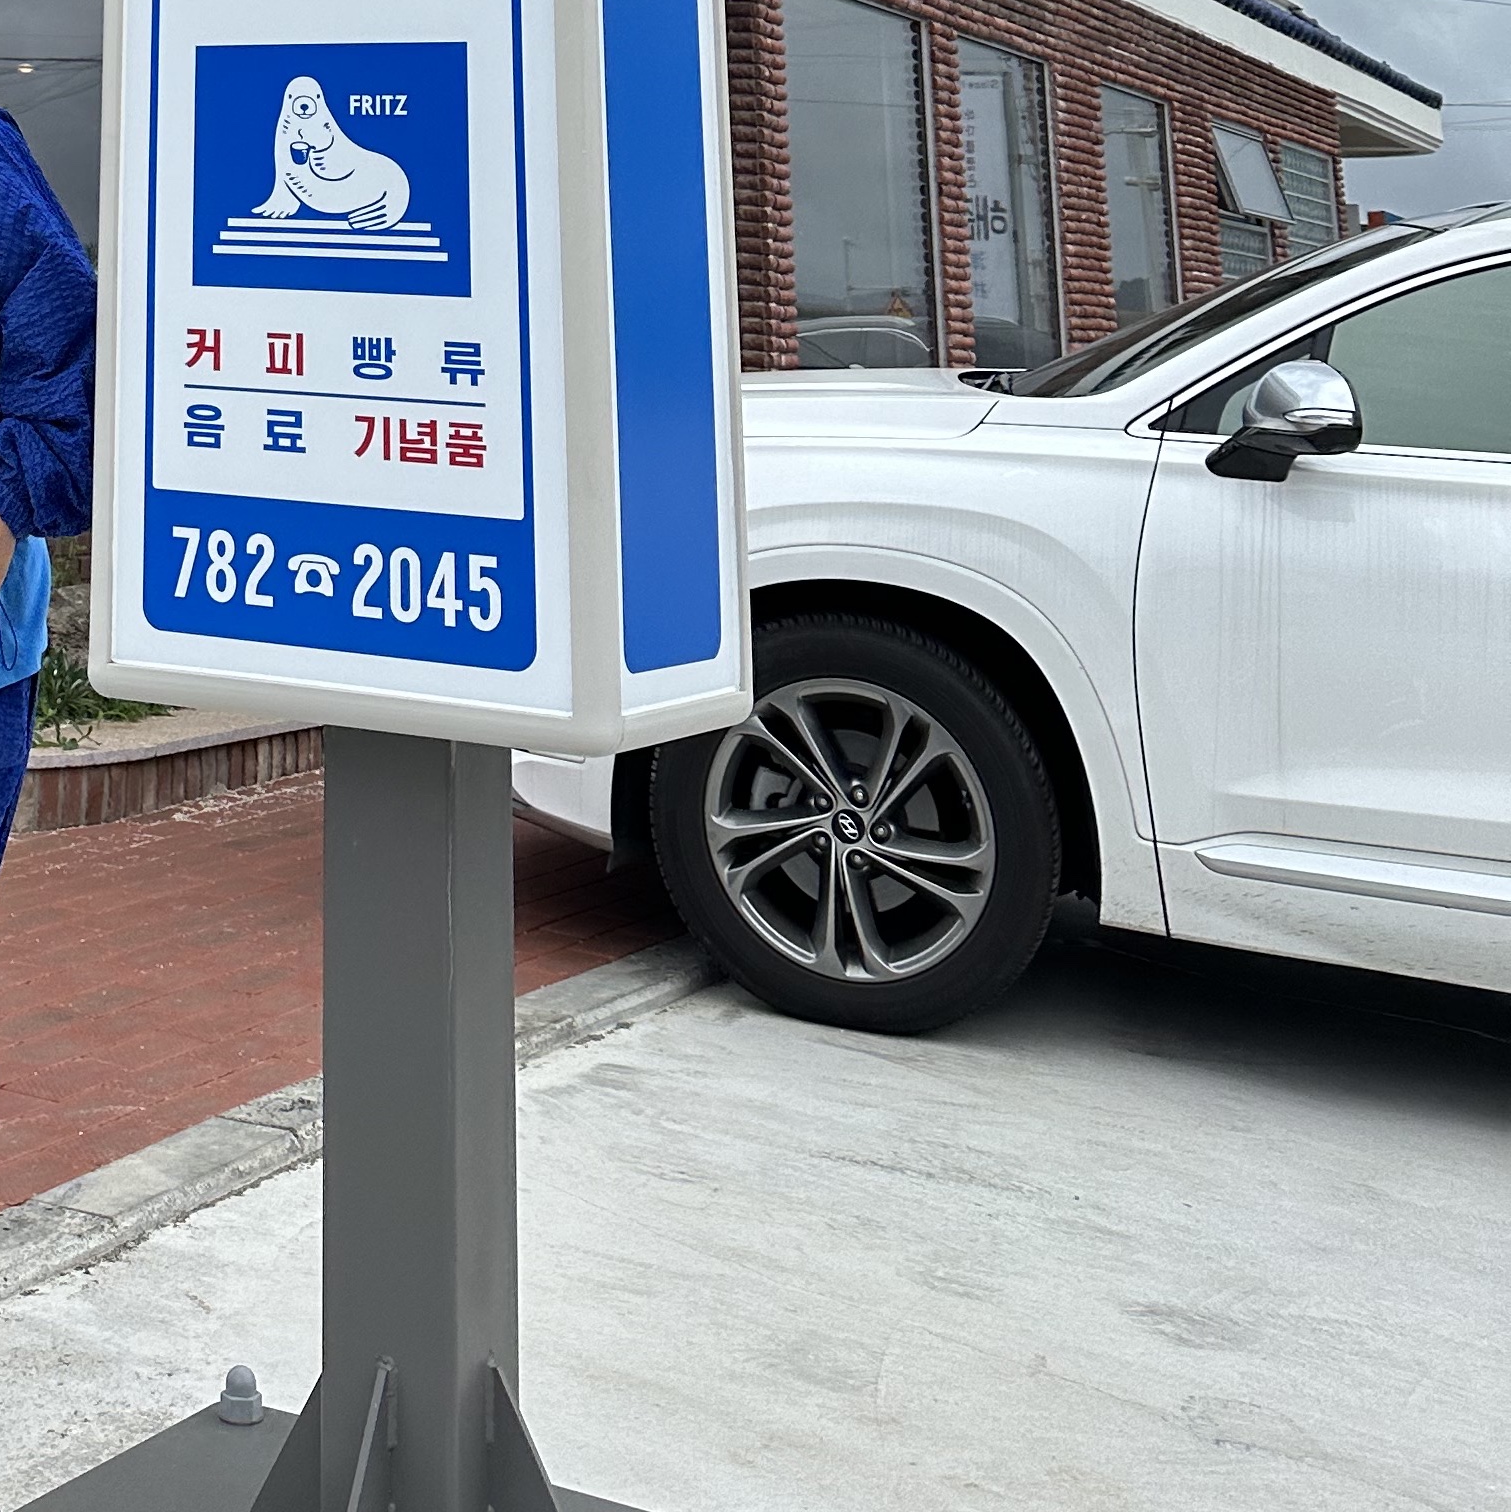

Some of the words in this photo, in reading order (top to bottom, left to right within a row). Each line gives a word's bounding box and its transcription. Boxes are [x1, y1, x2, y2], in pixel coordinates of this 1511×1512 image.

[349, 94, 408, 116] FRITZ
[354, 415, 487, 468] 기념품
[172, 526, 276, 607] 782
[352, 543, 503, 631] 2045
